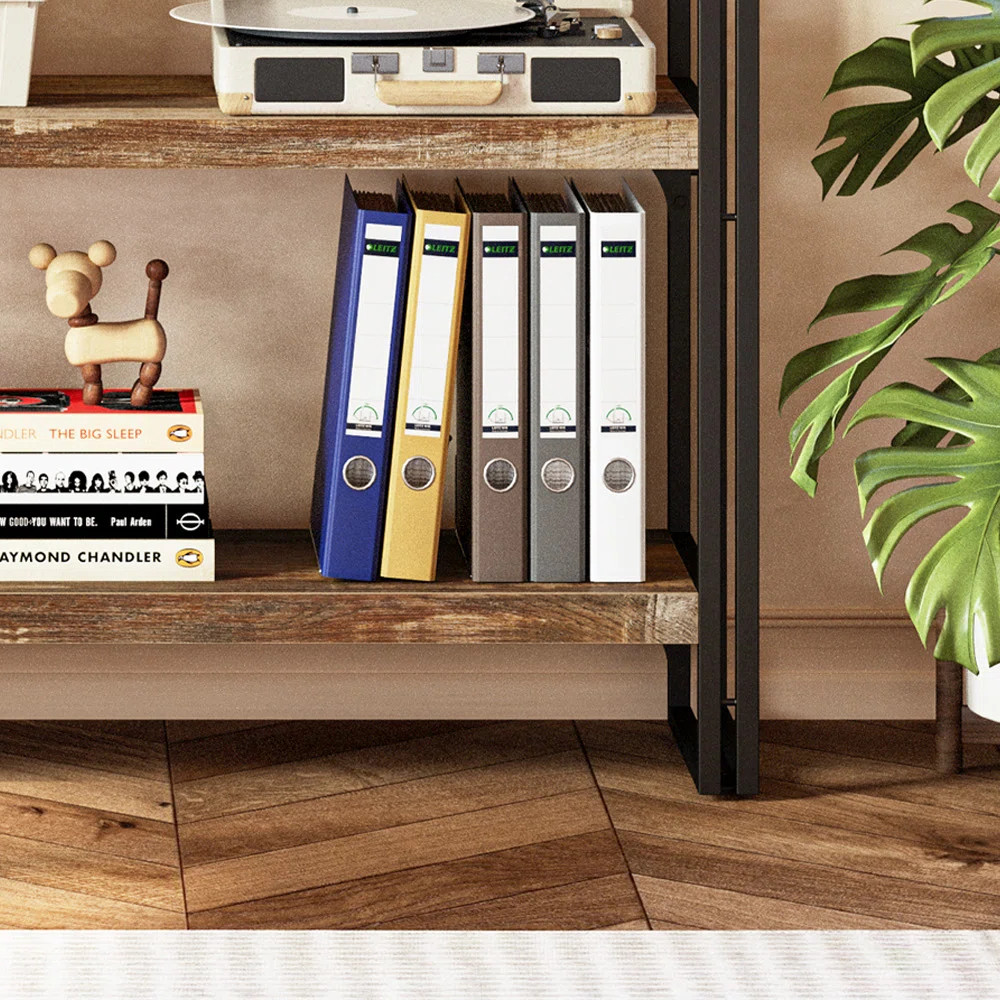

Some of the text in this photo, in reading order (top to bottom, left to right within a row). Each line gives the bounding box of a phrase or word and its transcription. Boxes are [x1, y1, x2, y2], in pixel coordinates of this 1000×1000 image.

[373, 244, 397, 253] LEITZ
[432, 244, 456, 253] LEITZ
[491, 245, 516, 253] LEITZ
[549, 245, 573, 253] LEITZ
[609, 245, 633, 253] LEITZ
[49, 428, 75, 440] THE
[79, 428, 102, 440] BIG
[105, 428, 143, 440] SLEEP
[31, 516, 47, 527] YOU
[49, 516, 71, 527] WANT
[73, 516, 83, 527] TO
[85, 516, 98, 527] BE.
[110, 516, 152, 527] Paul Arden
[77, 551, 162, 563] CHANDLER
